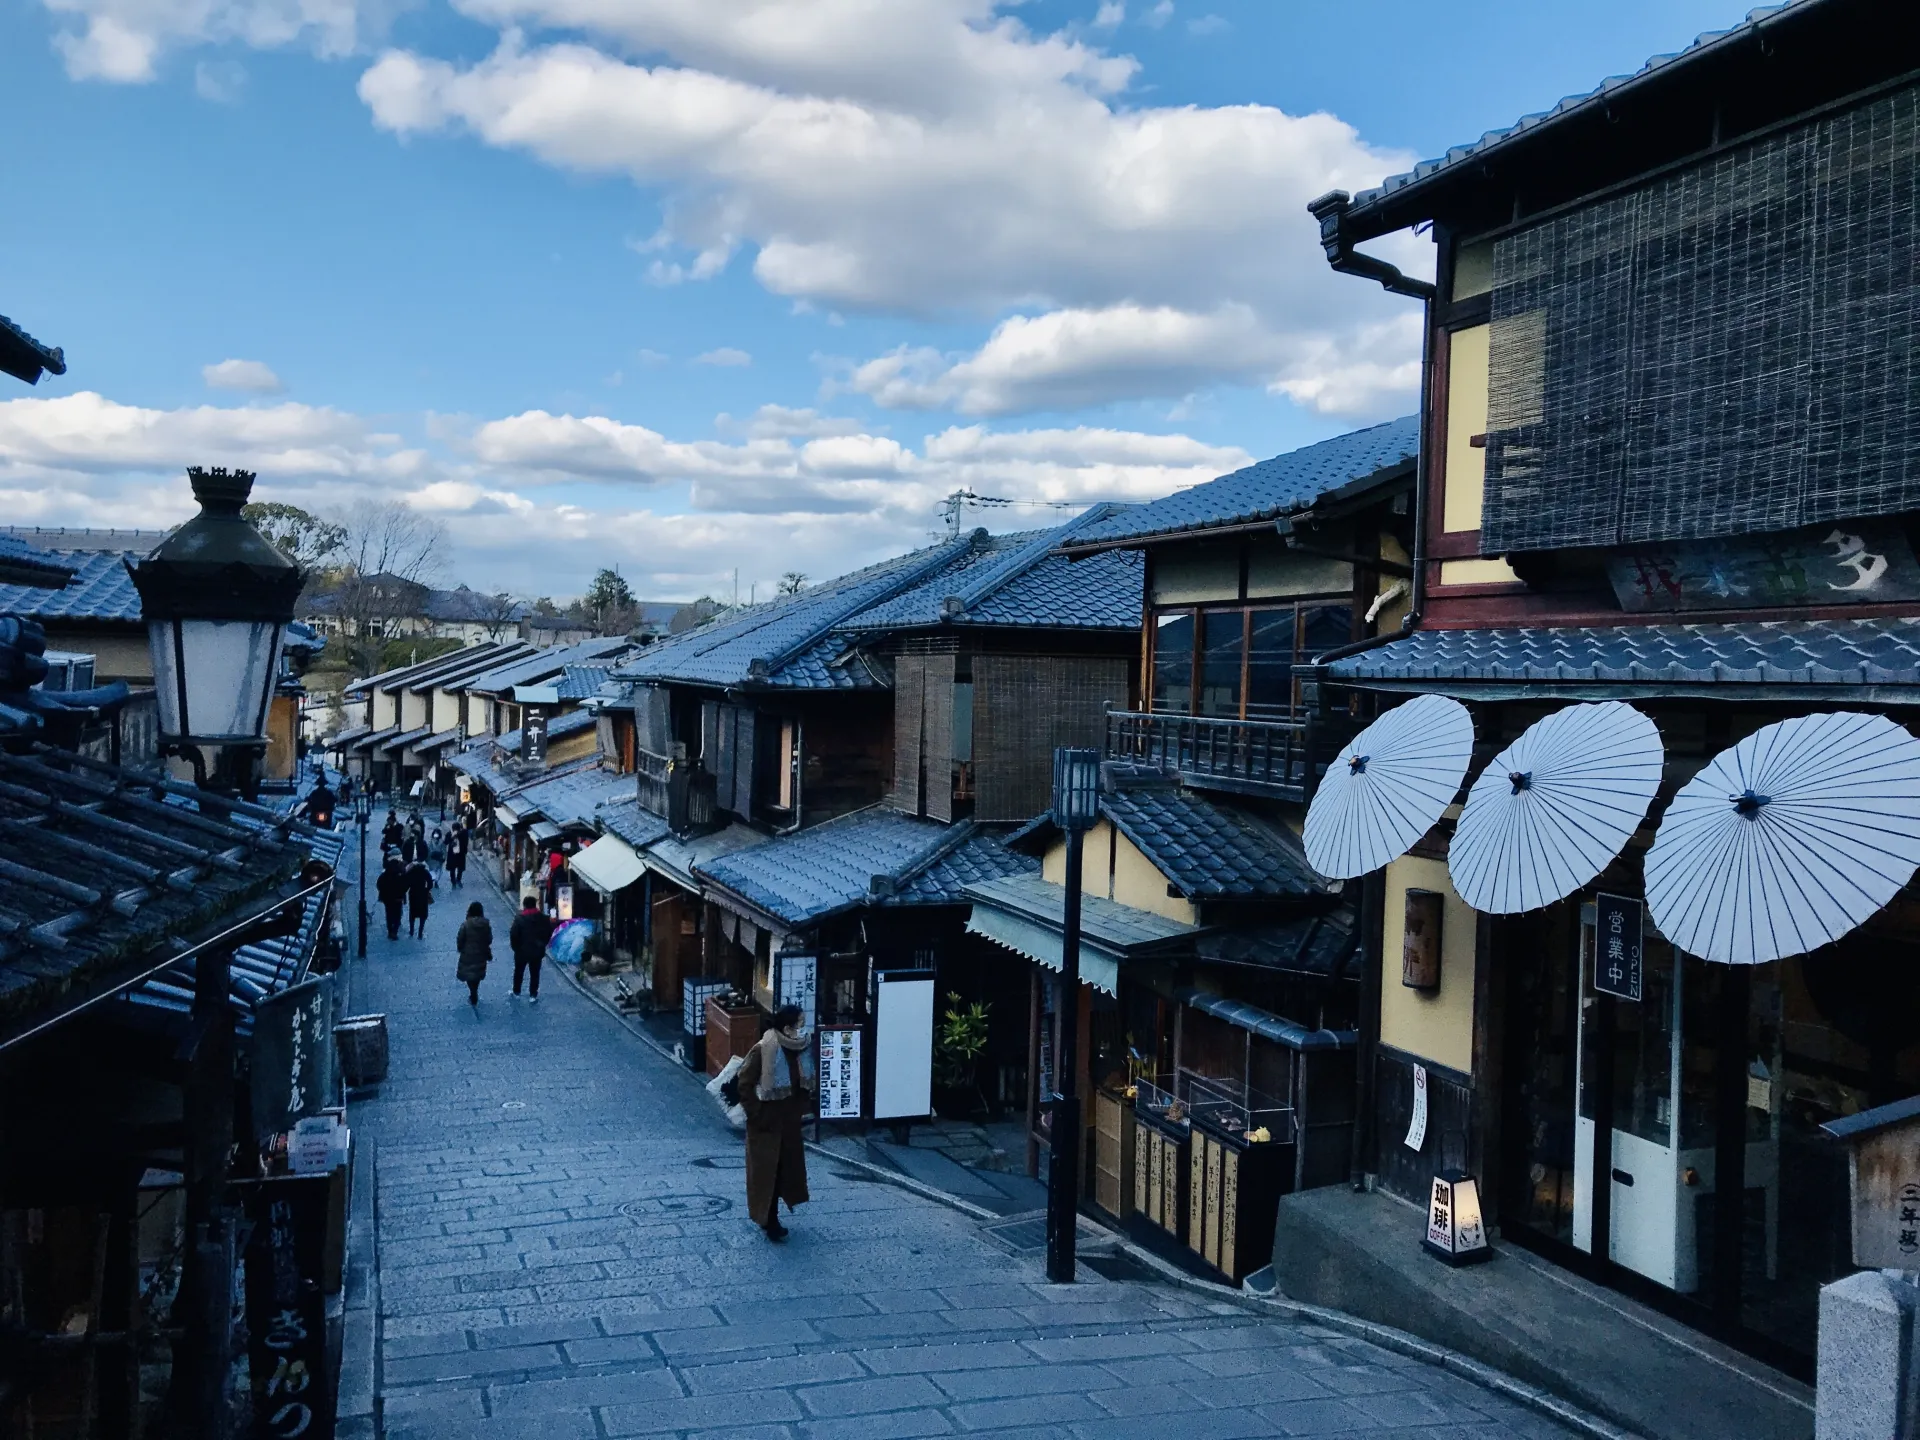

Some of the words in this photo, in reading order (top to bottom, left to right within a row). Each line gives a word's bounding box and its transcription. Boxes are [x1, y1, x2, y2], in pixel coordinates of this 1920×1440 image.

[527, 708, 544, 761] 二井三
[1608, 910, 1625, 986] 営業中
[1630, 945, 1640, 998] OPEN
[310, 993, 324, 1043] 甘党
[1433, 1183, 1449, 1231] 珈琲
[1430, 1228, 1451, 1247] COFFEE
